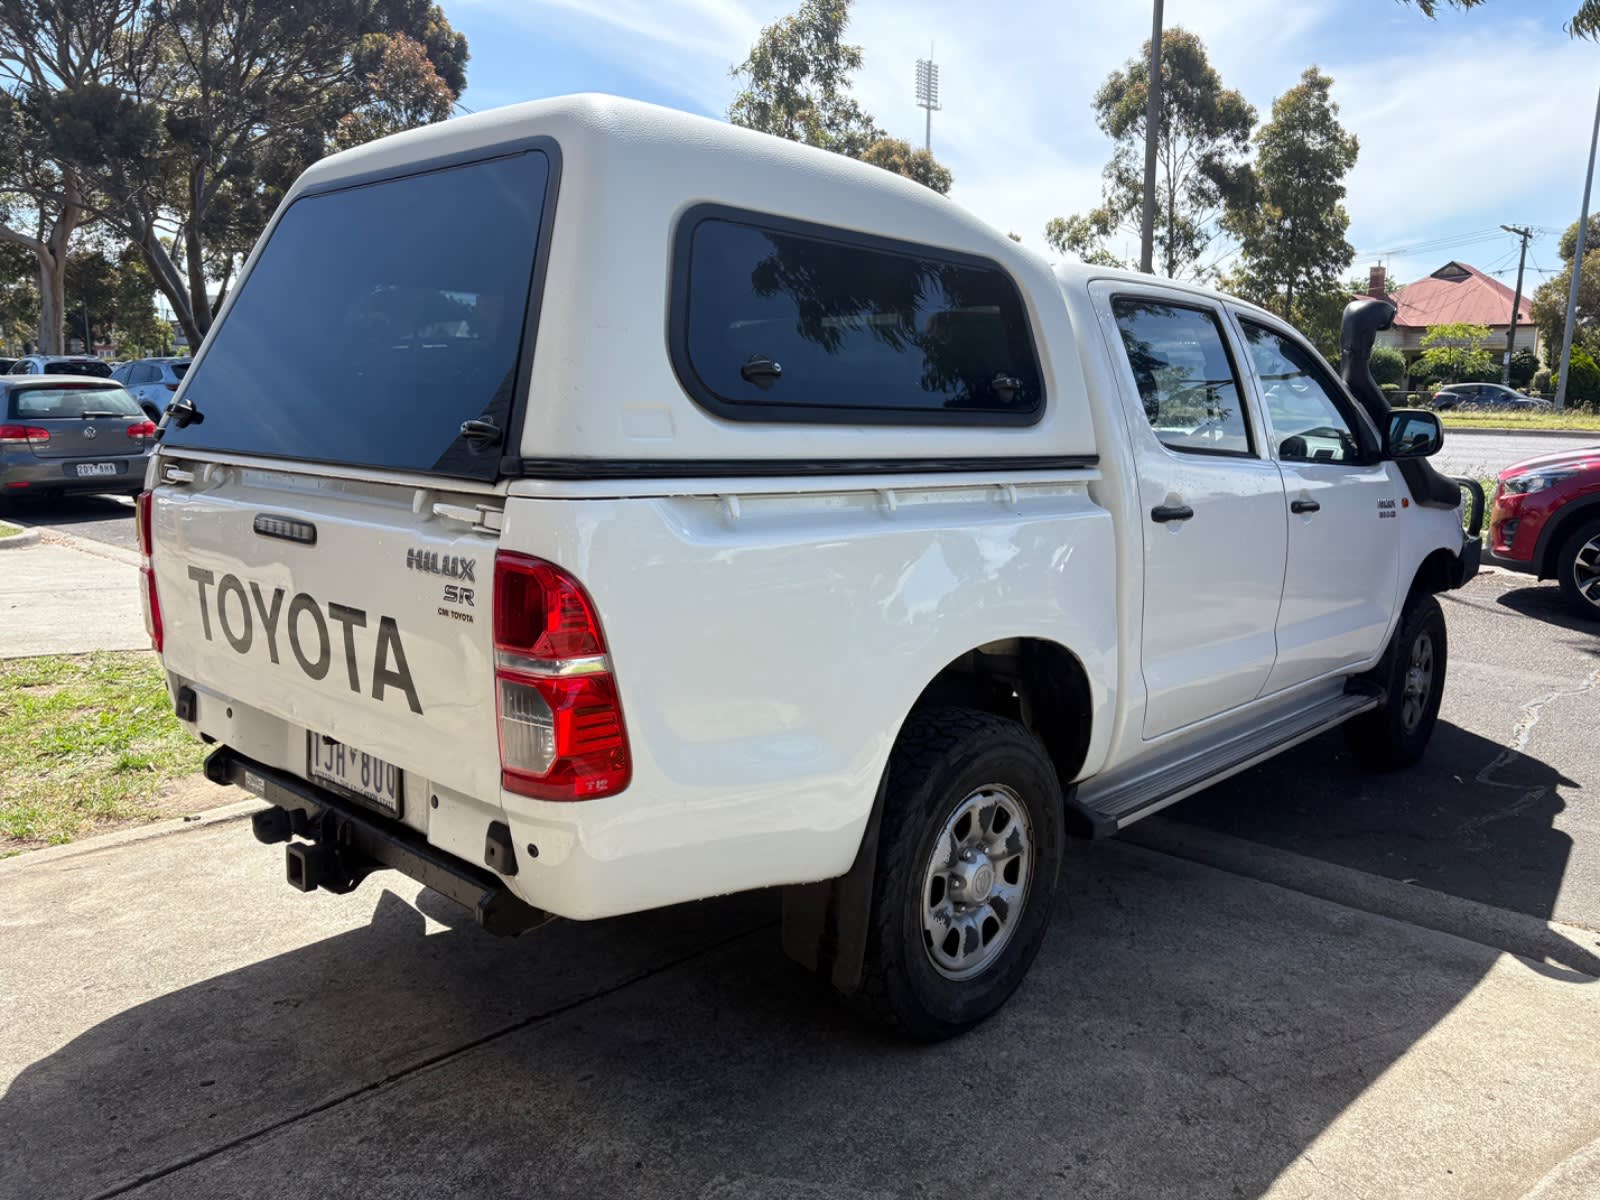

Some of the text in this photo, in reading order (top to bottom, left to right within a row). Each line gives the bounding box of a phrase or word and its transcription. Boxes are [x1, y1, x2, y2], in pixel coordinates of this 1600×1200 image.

[407, 547, 476, 583] HILUX
[443, 584, 475, 607] SR
[451, 610, 474, 623] TOYOTA
[187, 565, 424, 715] TOYOTA
